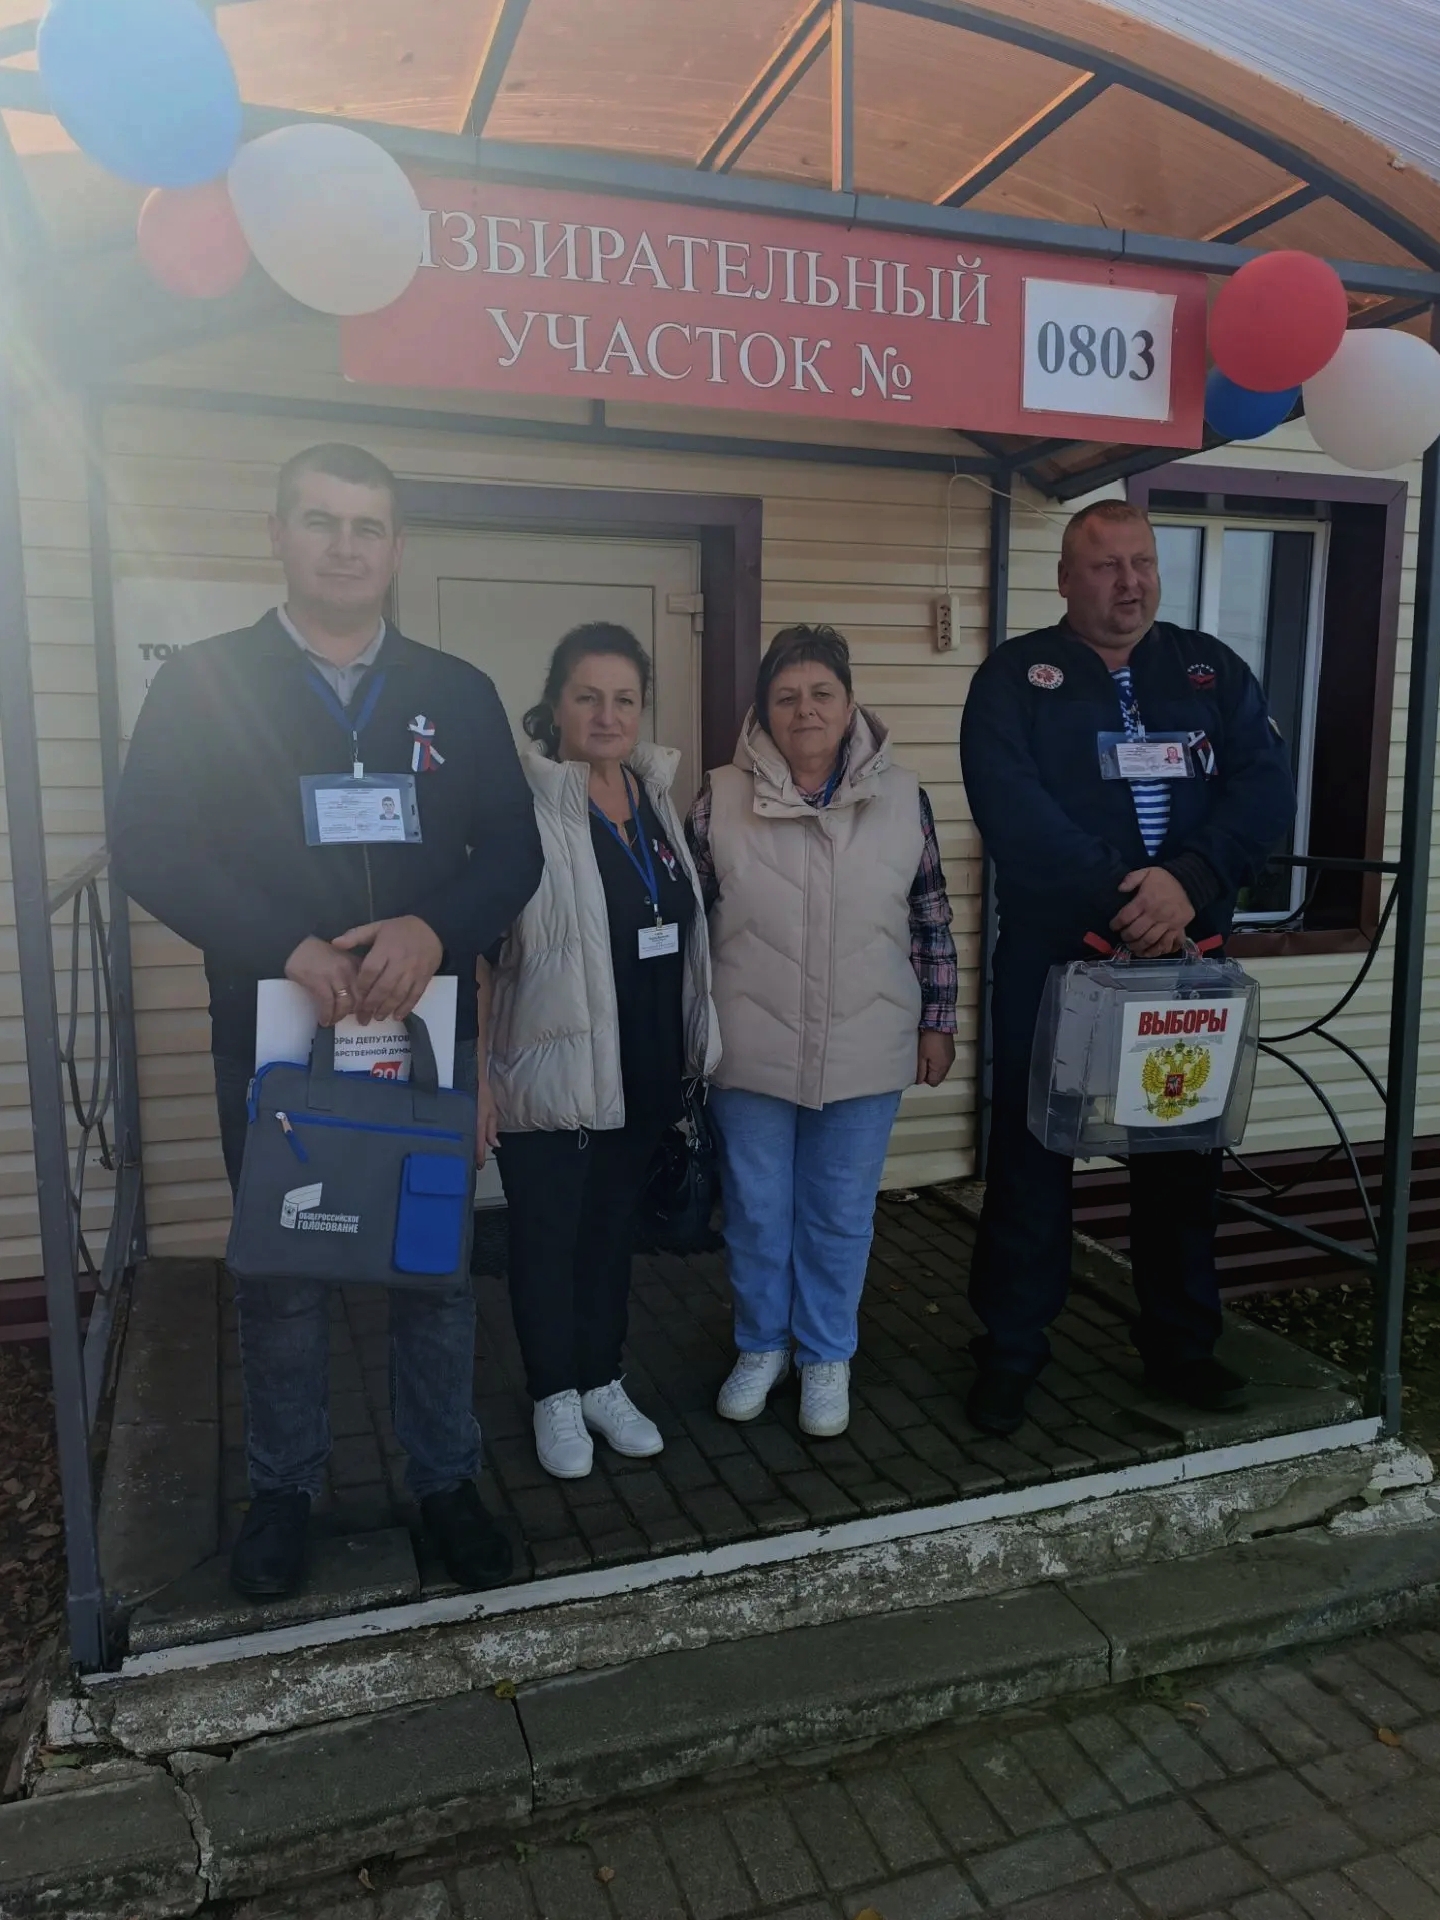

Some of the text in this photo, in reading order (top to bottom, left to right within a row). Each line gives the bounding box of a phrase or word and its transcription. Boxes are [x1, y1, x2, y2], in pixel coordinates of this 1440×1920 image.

[485, 307, 913, 401] УЧАСТОК №
[1036, 320, 1156, 381] 0803
[1137, 1008, 1229, 1036] ВЫБОРЫ
[334, 1046, 388, 1057] АРСТВЕННОЙ
[297, 1220, 359, 1234] ГОЛОСОВАНИЕ
